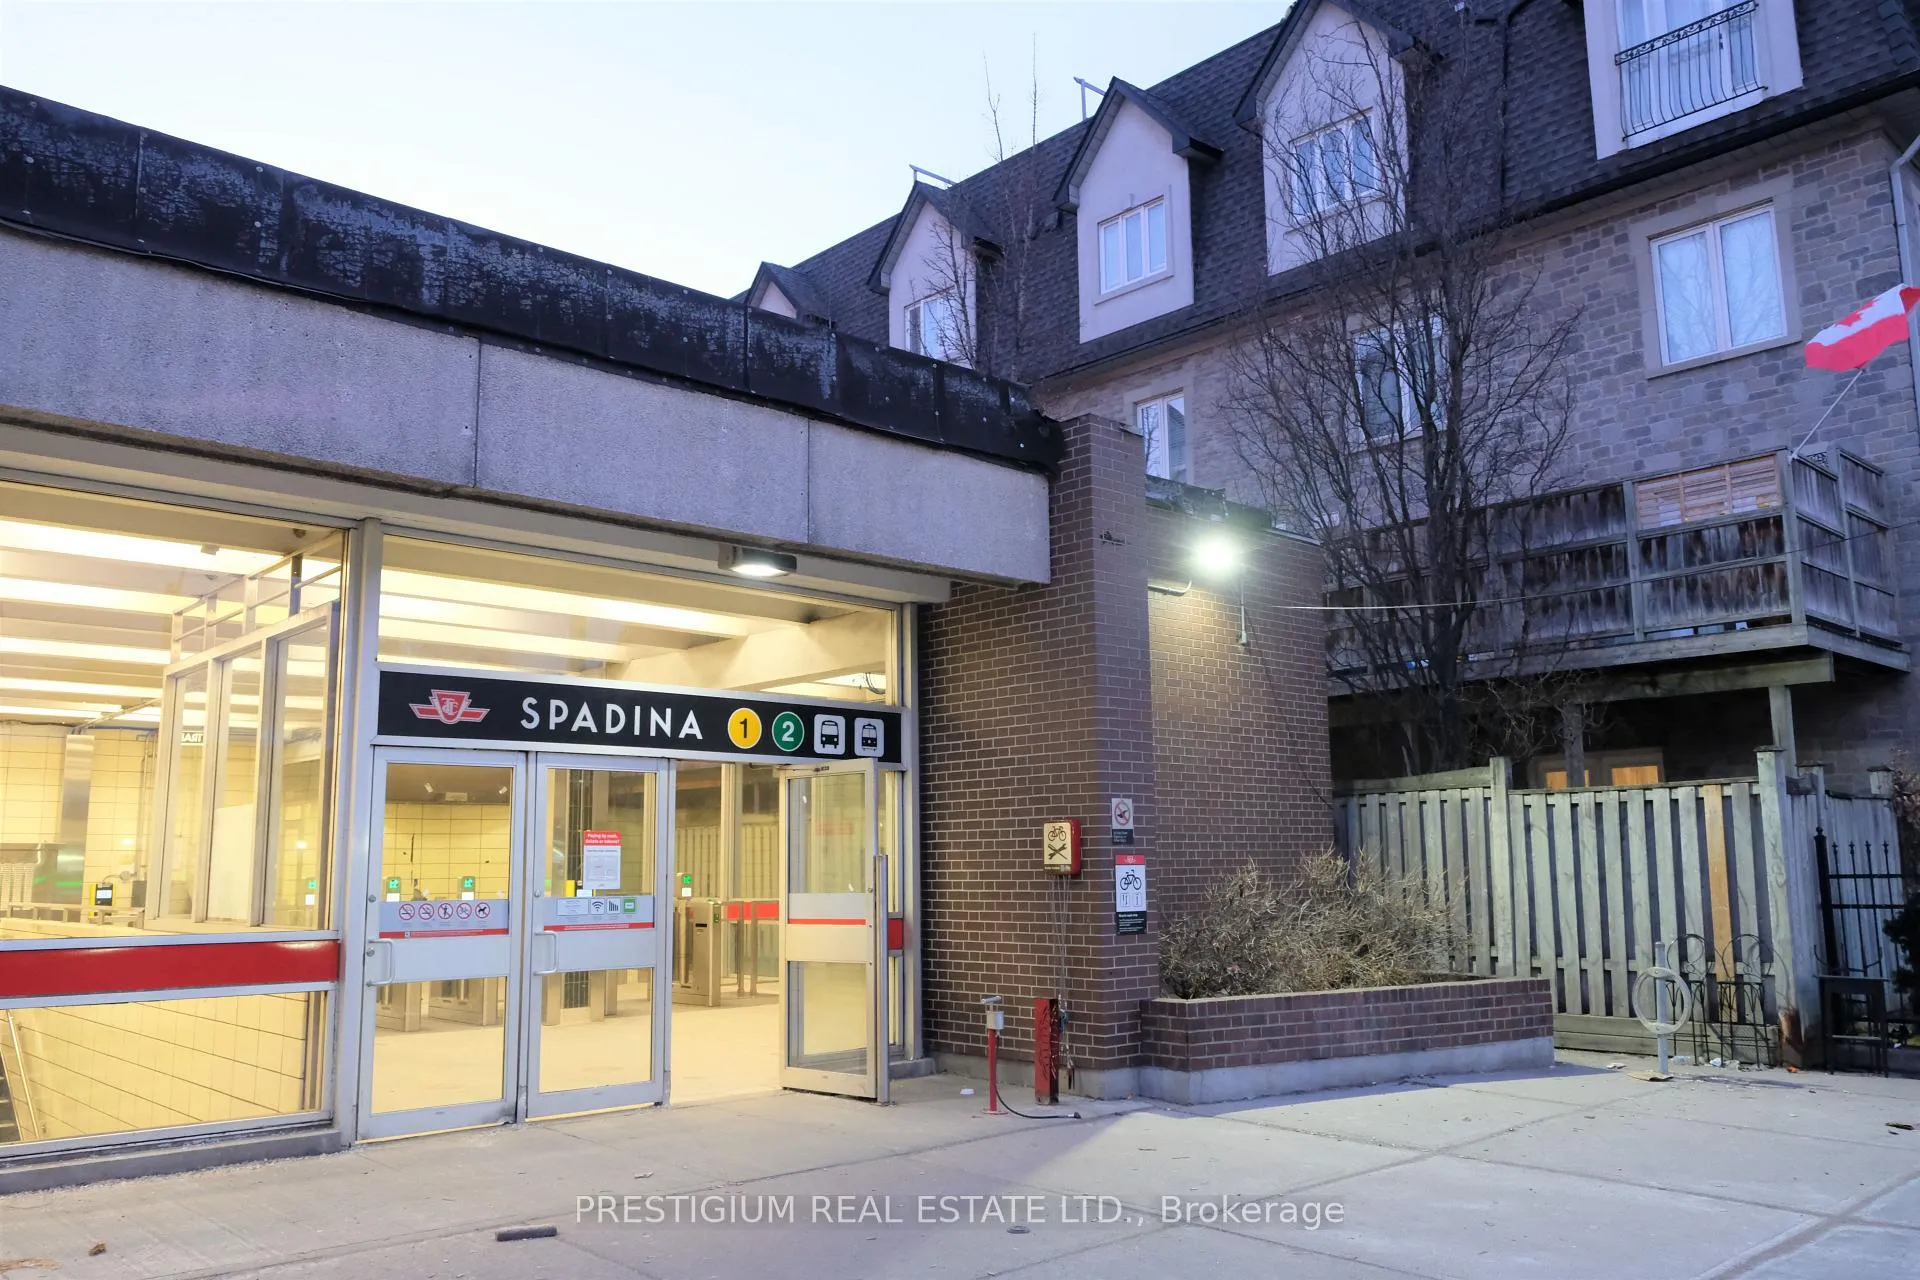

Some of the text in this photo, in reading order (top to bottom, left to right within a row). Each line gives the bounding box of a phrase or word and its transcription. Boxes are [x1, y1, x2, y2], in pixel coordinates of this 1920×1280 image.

[520, 696, 703, 740] SPADINA
[739, 717, 748, 739] 1
[781, 720, 795, 742] 2
